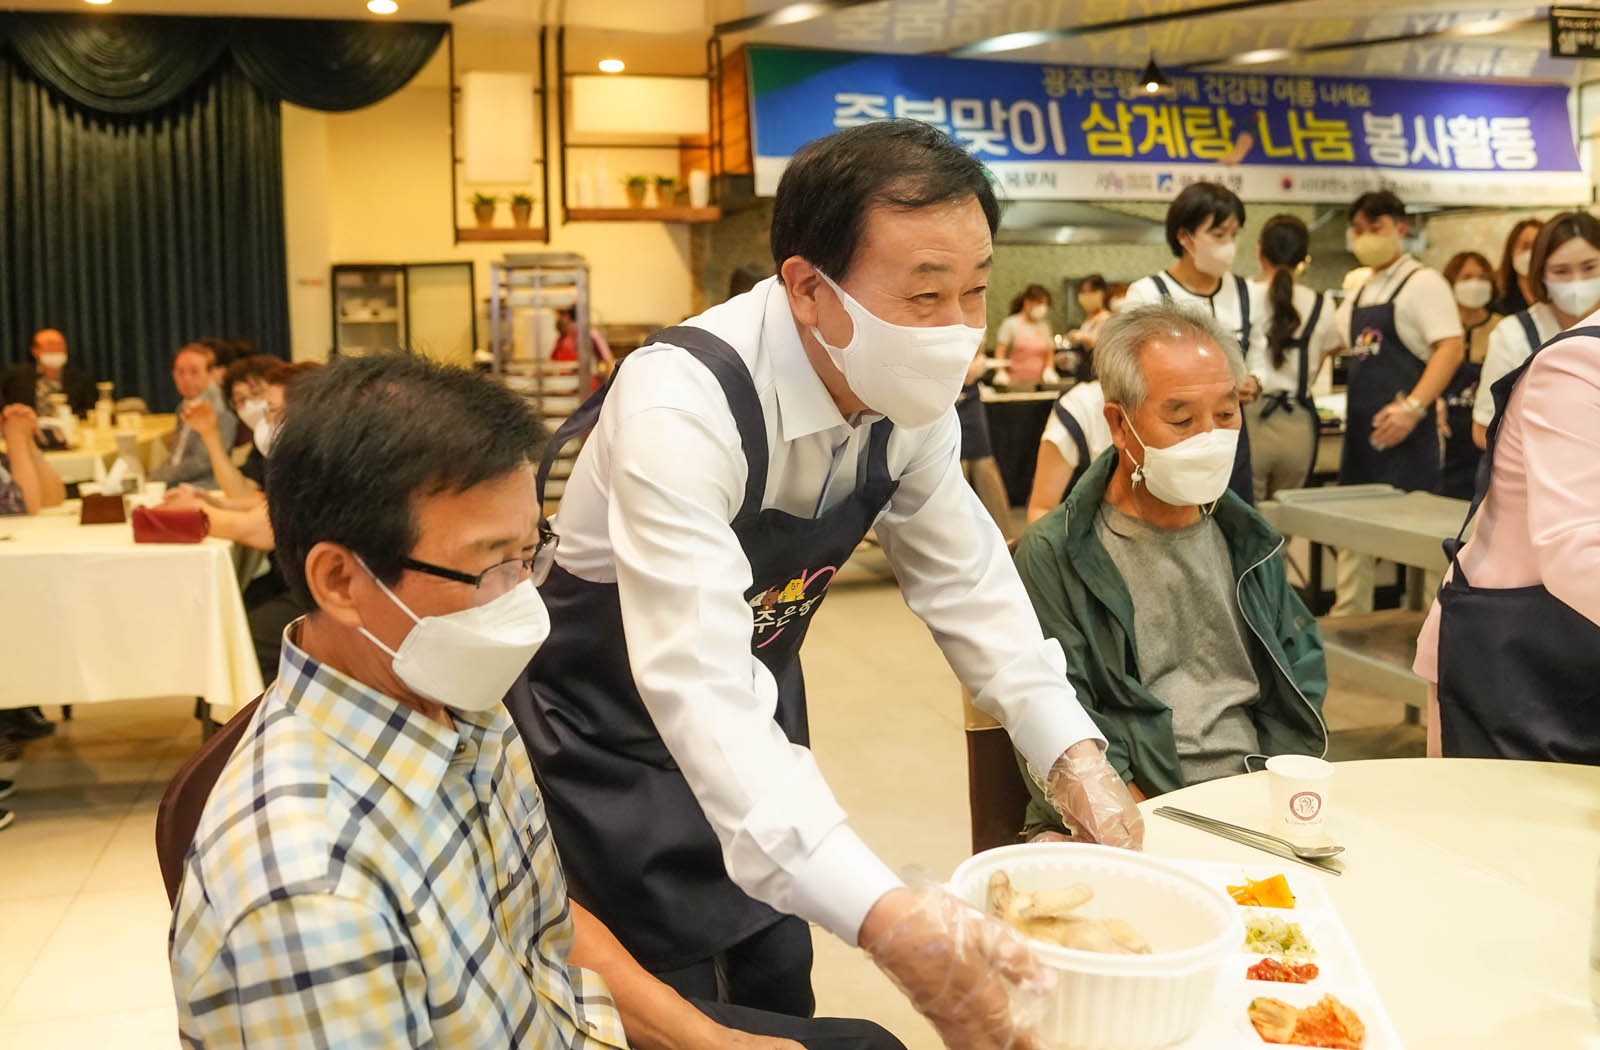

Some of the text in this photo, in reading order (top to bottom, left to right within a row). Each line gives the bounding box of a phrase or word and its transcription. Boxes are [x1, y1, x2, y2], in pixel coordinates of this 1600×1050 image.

[1042, 66, 1141, 99] 광주은행
[1081, 101, 1235, 160] 삼계탕
[1256, 108, 1355, 163] 나눔
[1363, 111, 1538, 170] 봉사활동
